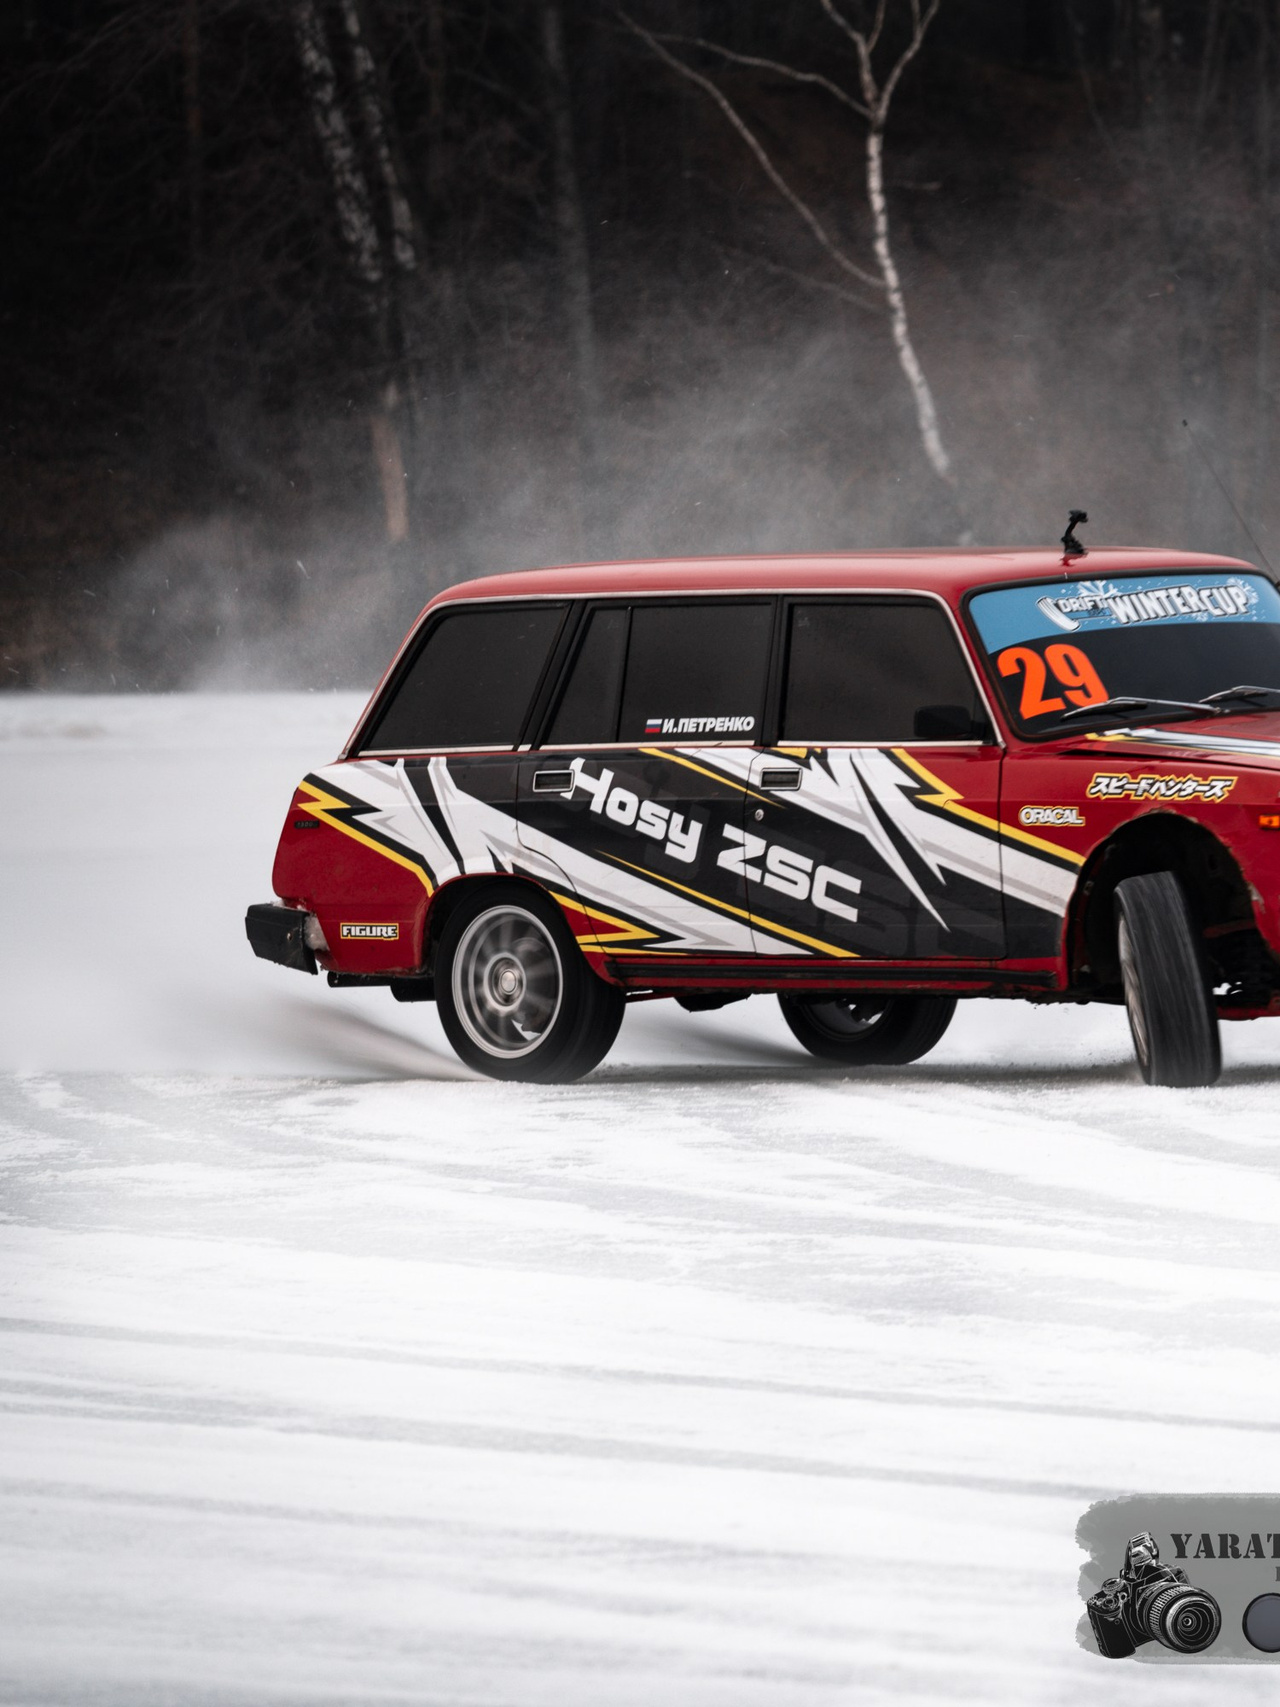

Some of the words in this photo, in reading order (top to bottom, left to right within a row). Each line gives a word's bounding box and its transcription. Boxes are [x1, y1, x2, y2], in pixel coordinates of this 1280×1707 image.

[1056, 595, 1107, 613] DRIFT
[1107, 585, 1206, 624] WINTER
[1200, 586, 1249, 617] CUP
[997, 643, 1109, 720] 29
[661, 715, 755, 734] И.ПЕТРЕНКО
[1089, 775, 1233, 800] スピードハンターズ
[1019, 807, 1084, 825] ORACAL
[560, 757, 703, 864] Hosy
[717, 823, 862, 923] ZSC
[342, 925, 397, 938] FIGURE
